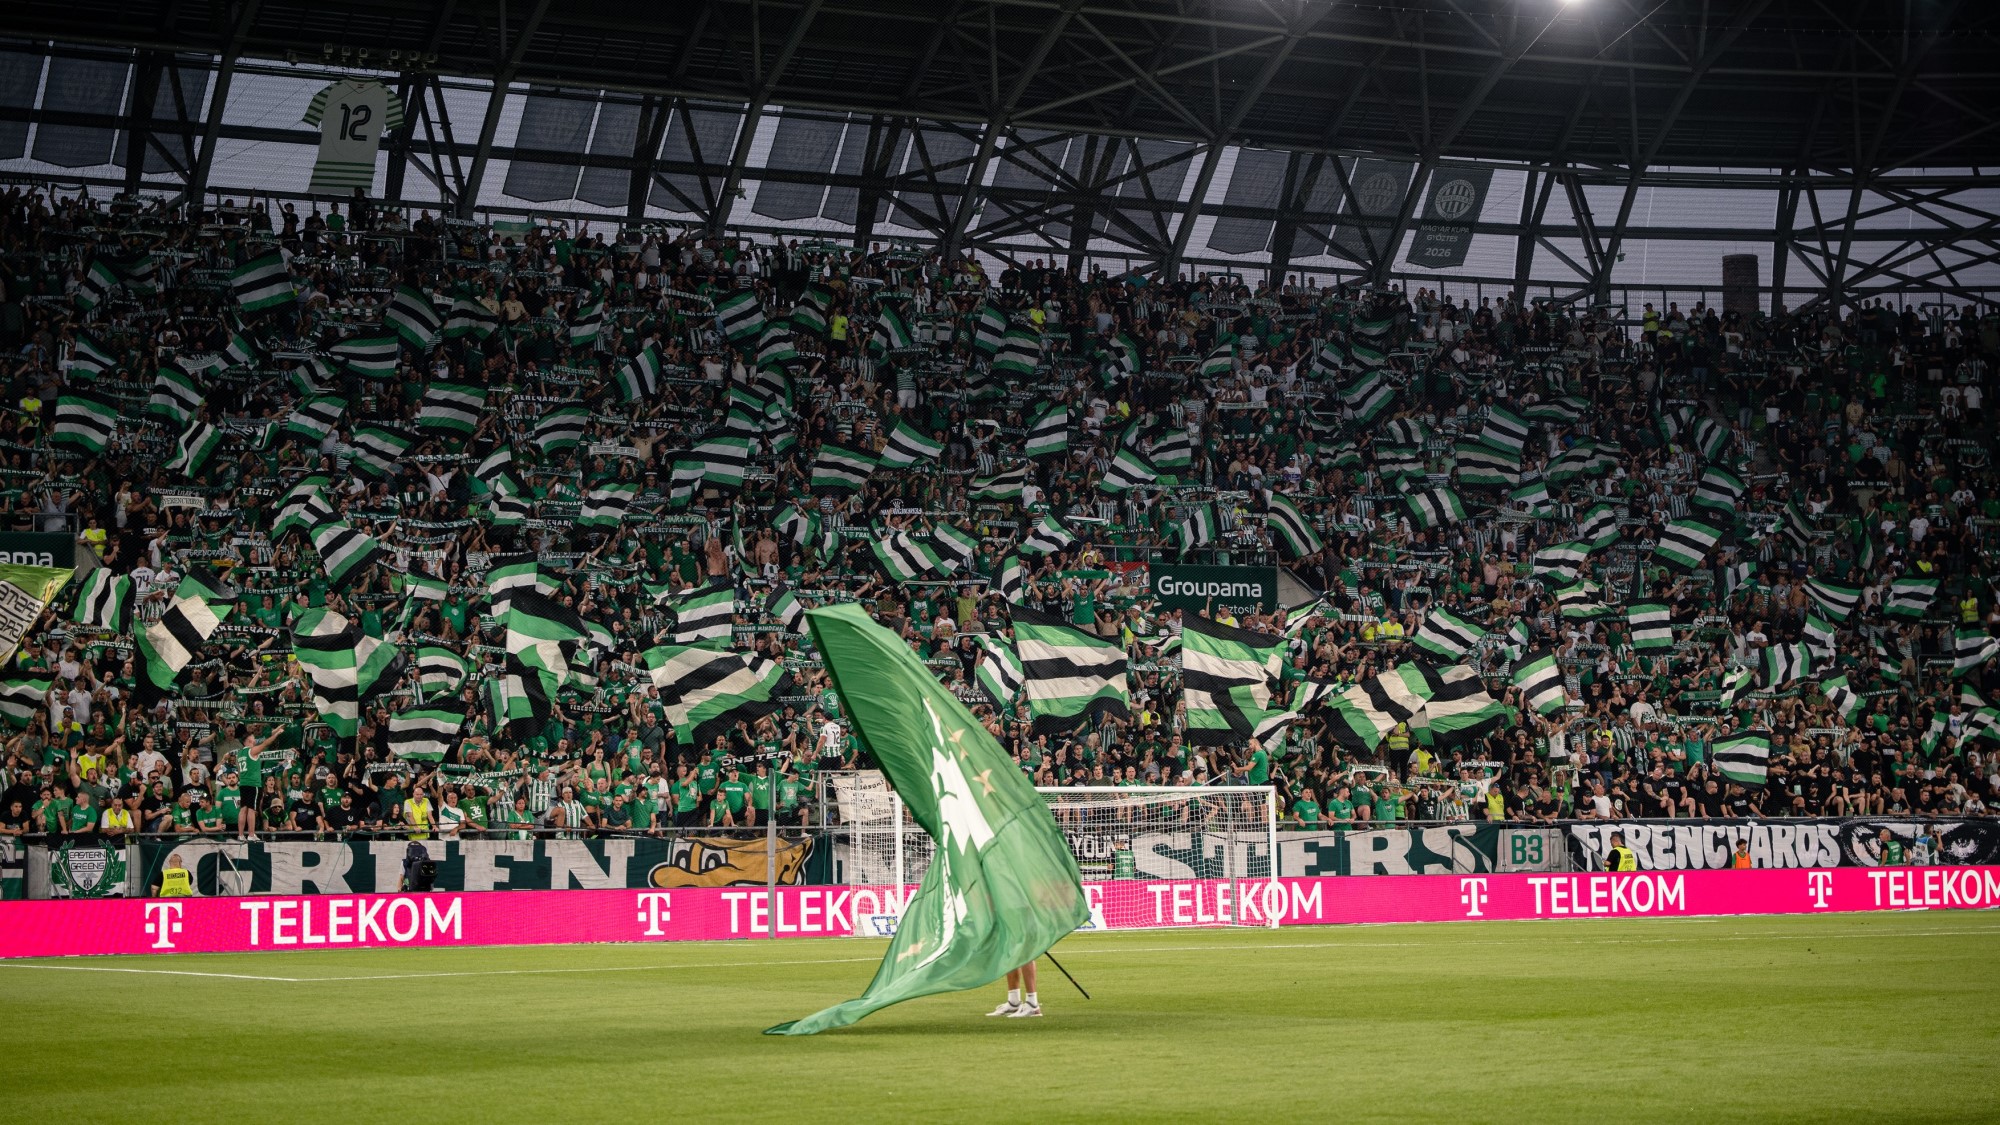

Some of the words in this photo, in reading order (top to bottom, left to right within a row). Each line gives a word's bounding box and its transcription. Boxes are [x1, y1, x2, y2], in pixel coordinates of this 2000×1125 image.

[340, 104, 371, 141] 12
[1424, 248, 1451, 257] 2026
[1158, 576, 1262, 597] Groupama
[1218, 603, 1263, 615] Bztosít
[69, 850, 106, 860] EASTERN
[1511, 834, 1544, 865] B3
[70, 861, 105, 871] GREENS
[1147, 881, 1323, 923] TELEKOM
[1527, 875, 1686, 915] TELEKOM
[1867, 867, 2000, 907] TELEKOM
[240, 896, 464, 946] TELEKOM
